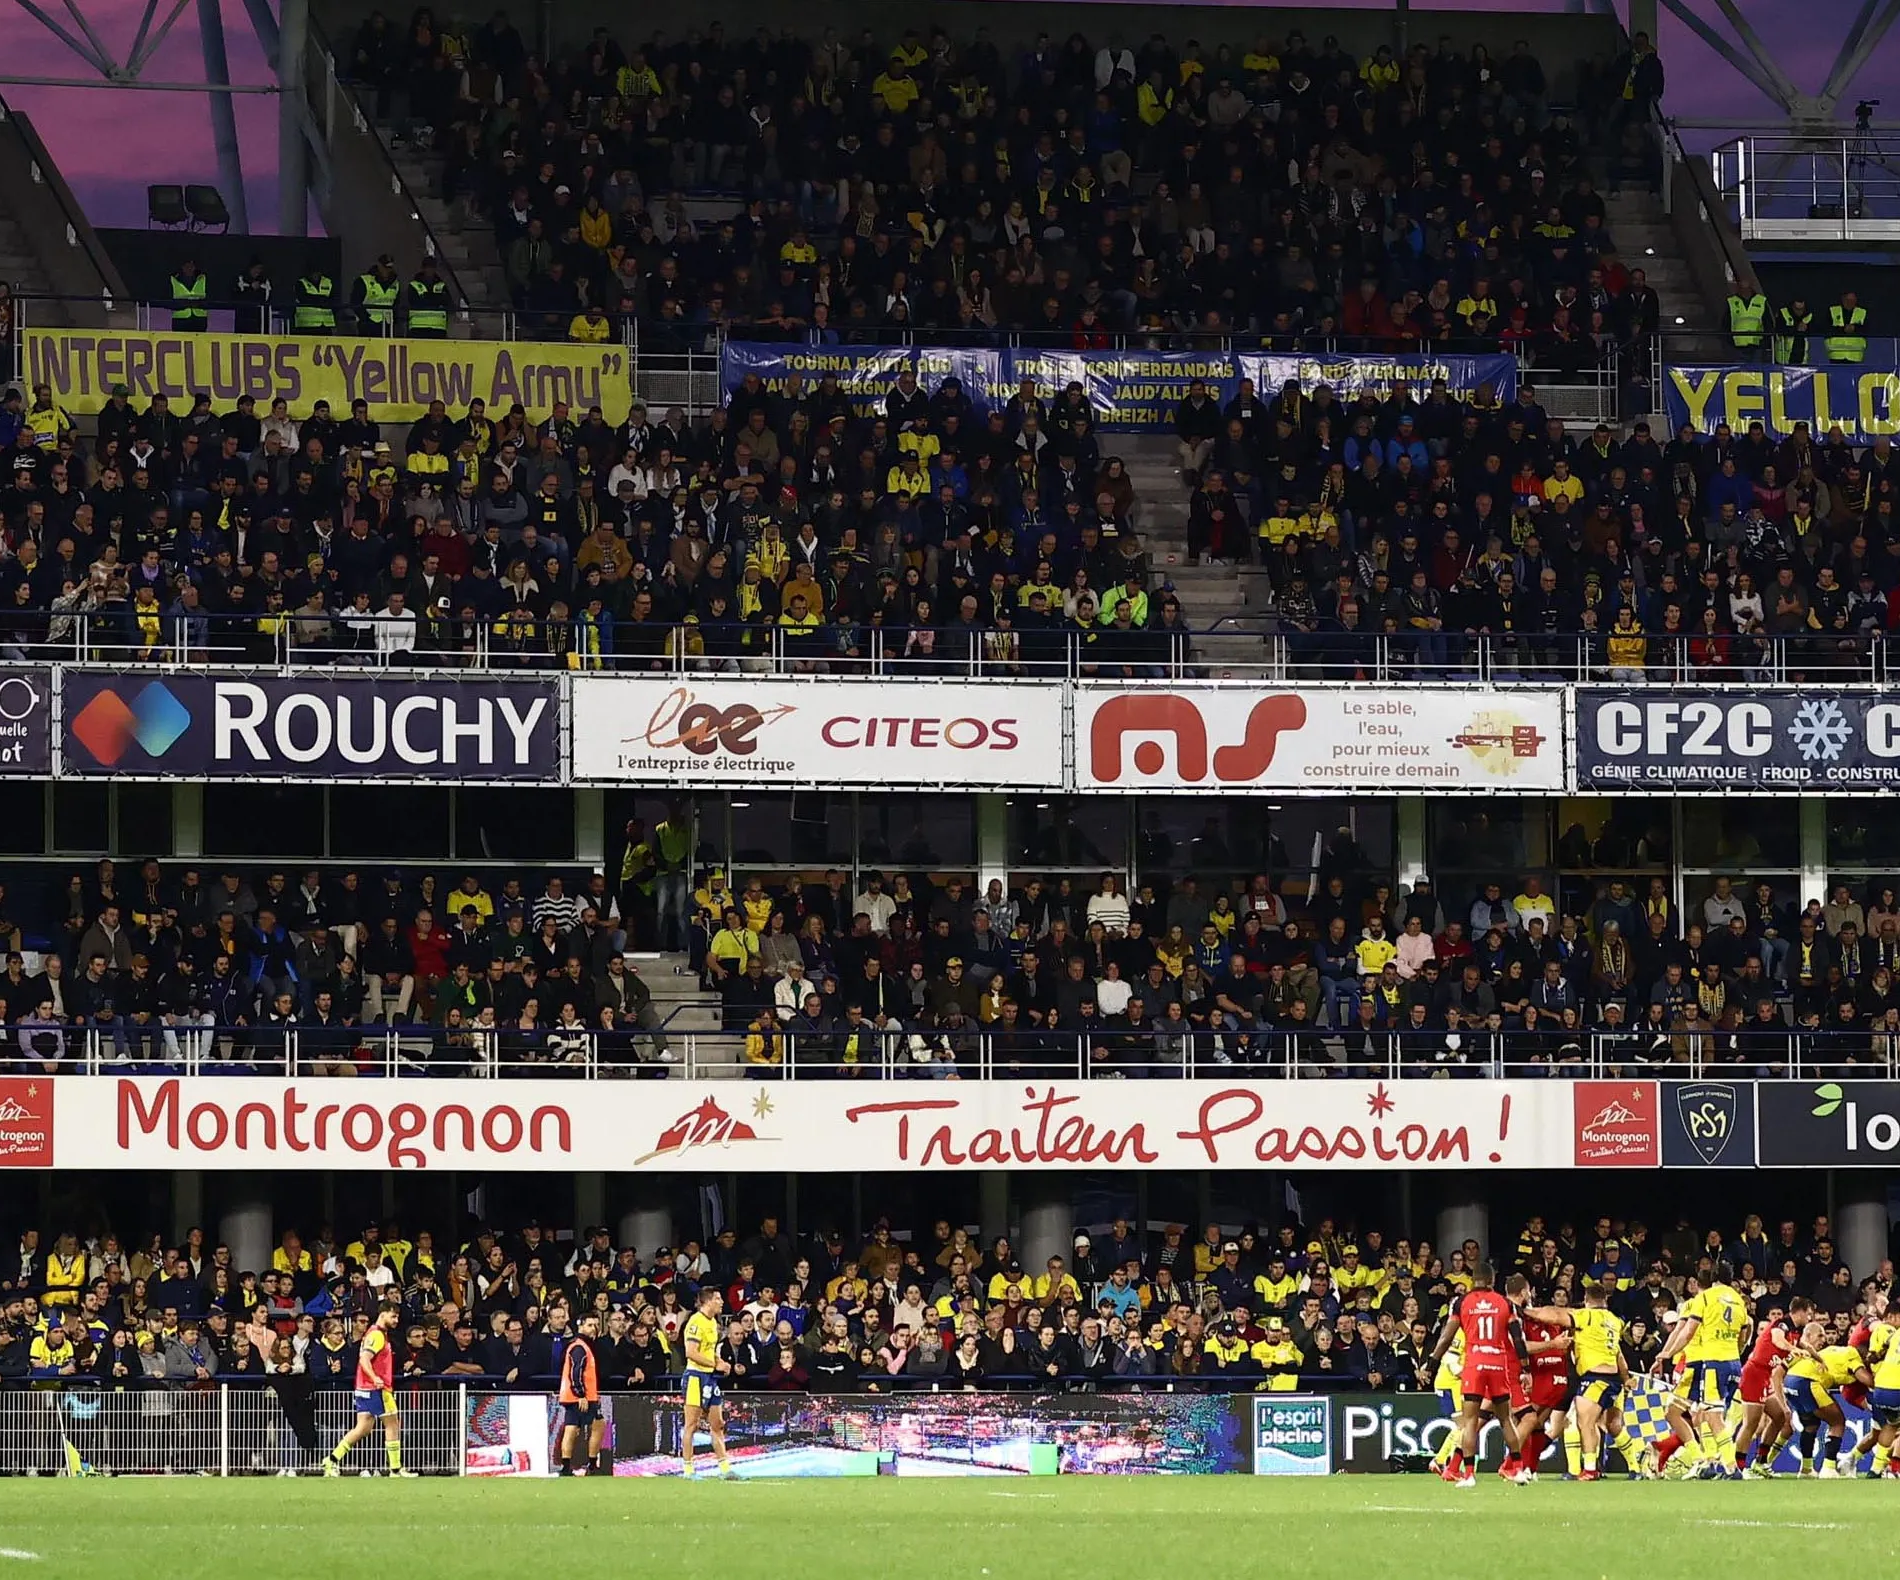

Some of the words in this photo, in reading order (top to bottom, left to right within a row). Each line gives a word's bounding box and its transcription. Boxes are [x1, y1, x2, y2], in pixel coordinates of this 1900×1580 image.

[28, 334, 300, 400] INTERCLUBS
[1099, 408, 1158, 424] BREIZH
[1343, 701, 1362, 715] Le
[1367, 700, 1417, 717] sable,
[214, 681, 548, 765] ROUCHY
[821, 716, 1018, 750] CITEOS
[1358, 720, 1403, 738] l'eau,
[1596, 700, 1772, 756] CF2C
[1332, 743, 1374, 759] pour
[1377, 741, 1431, 757] mieux
[617, 754, 711, 773] l'entreprise
[714, 755, 796, 775] électrique
[1303, 762, 1392, 778] construire
[1396, 762, 1460, 778] demain
[1591, 762, 1642, 778] GÉNIE
[1646, 764, 1748, 781] CLIMATIQUE
[1762, 766, 1812, 781] FROID
[116, 1077, 572, 1168] Montrognon
[845, 1086, 1159, 1166] Traiteur
[1176, 1083, 1470, 1165] Passion
[1582, 1130, 1650, 1146] Montrognon
[1723, 1305, 1732, 1323] 4
[1477, 1316, 1493, 1340] 11
[1261, 1405, 1322, 1428] l'esprit
[1261, 1427, 1323, 1446] piscine
[1343, 1403, 1556, 1461] Piscn
